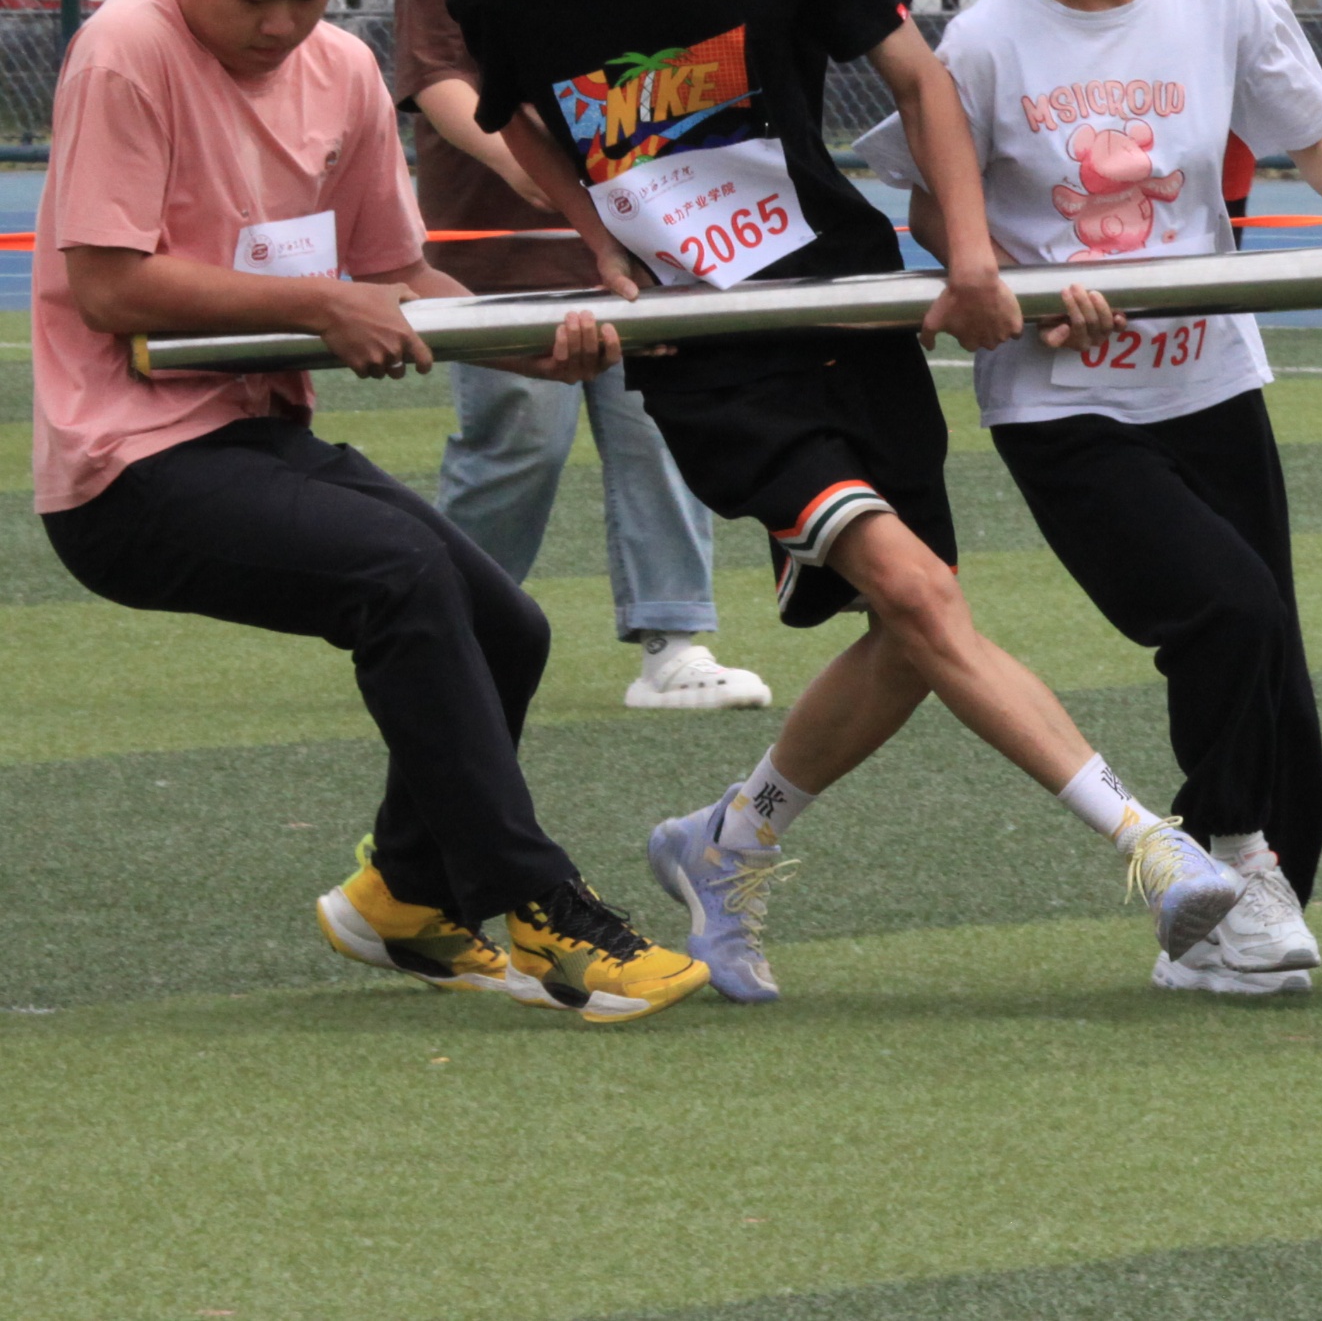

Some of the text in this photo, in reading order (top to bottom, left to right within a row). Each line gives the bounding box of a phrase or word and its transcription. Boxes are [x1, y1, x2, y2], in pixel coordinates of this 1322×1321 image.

[604, 62, 719, 148] NIKE
[1021, 80, 1186, 132] MSICROW
[662, 181, 736, 226] 电力产业学院
[1080, 319, 1207, 369] 02137
